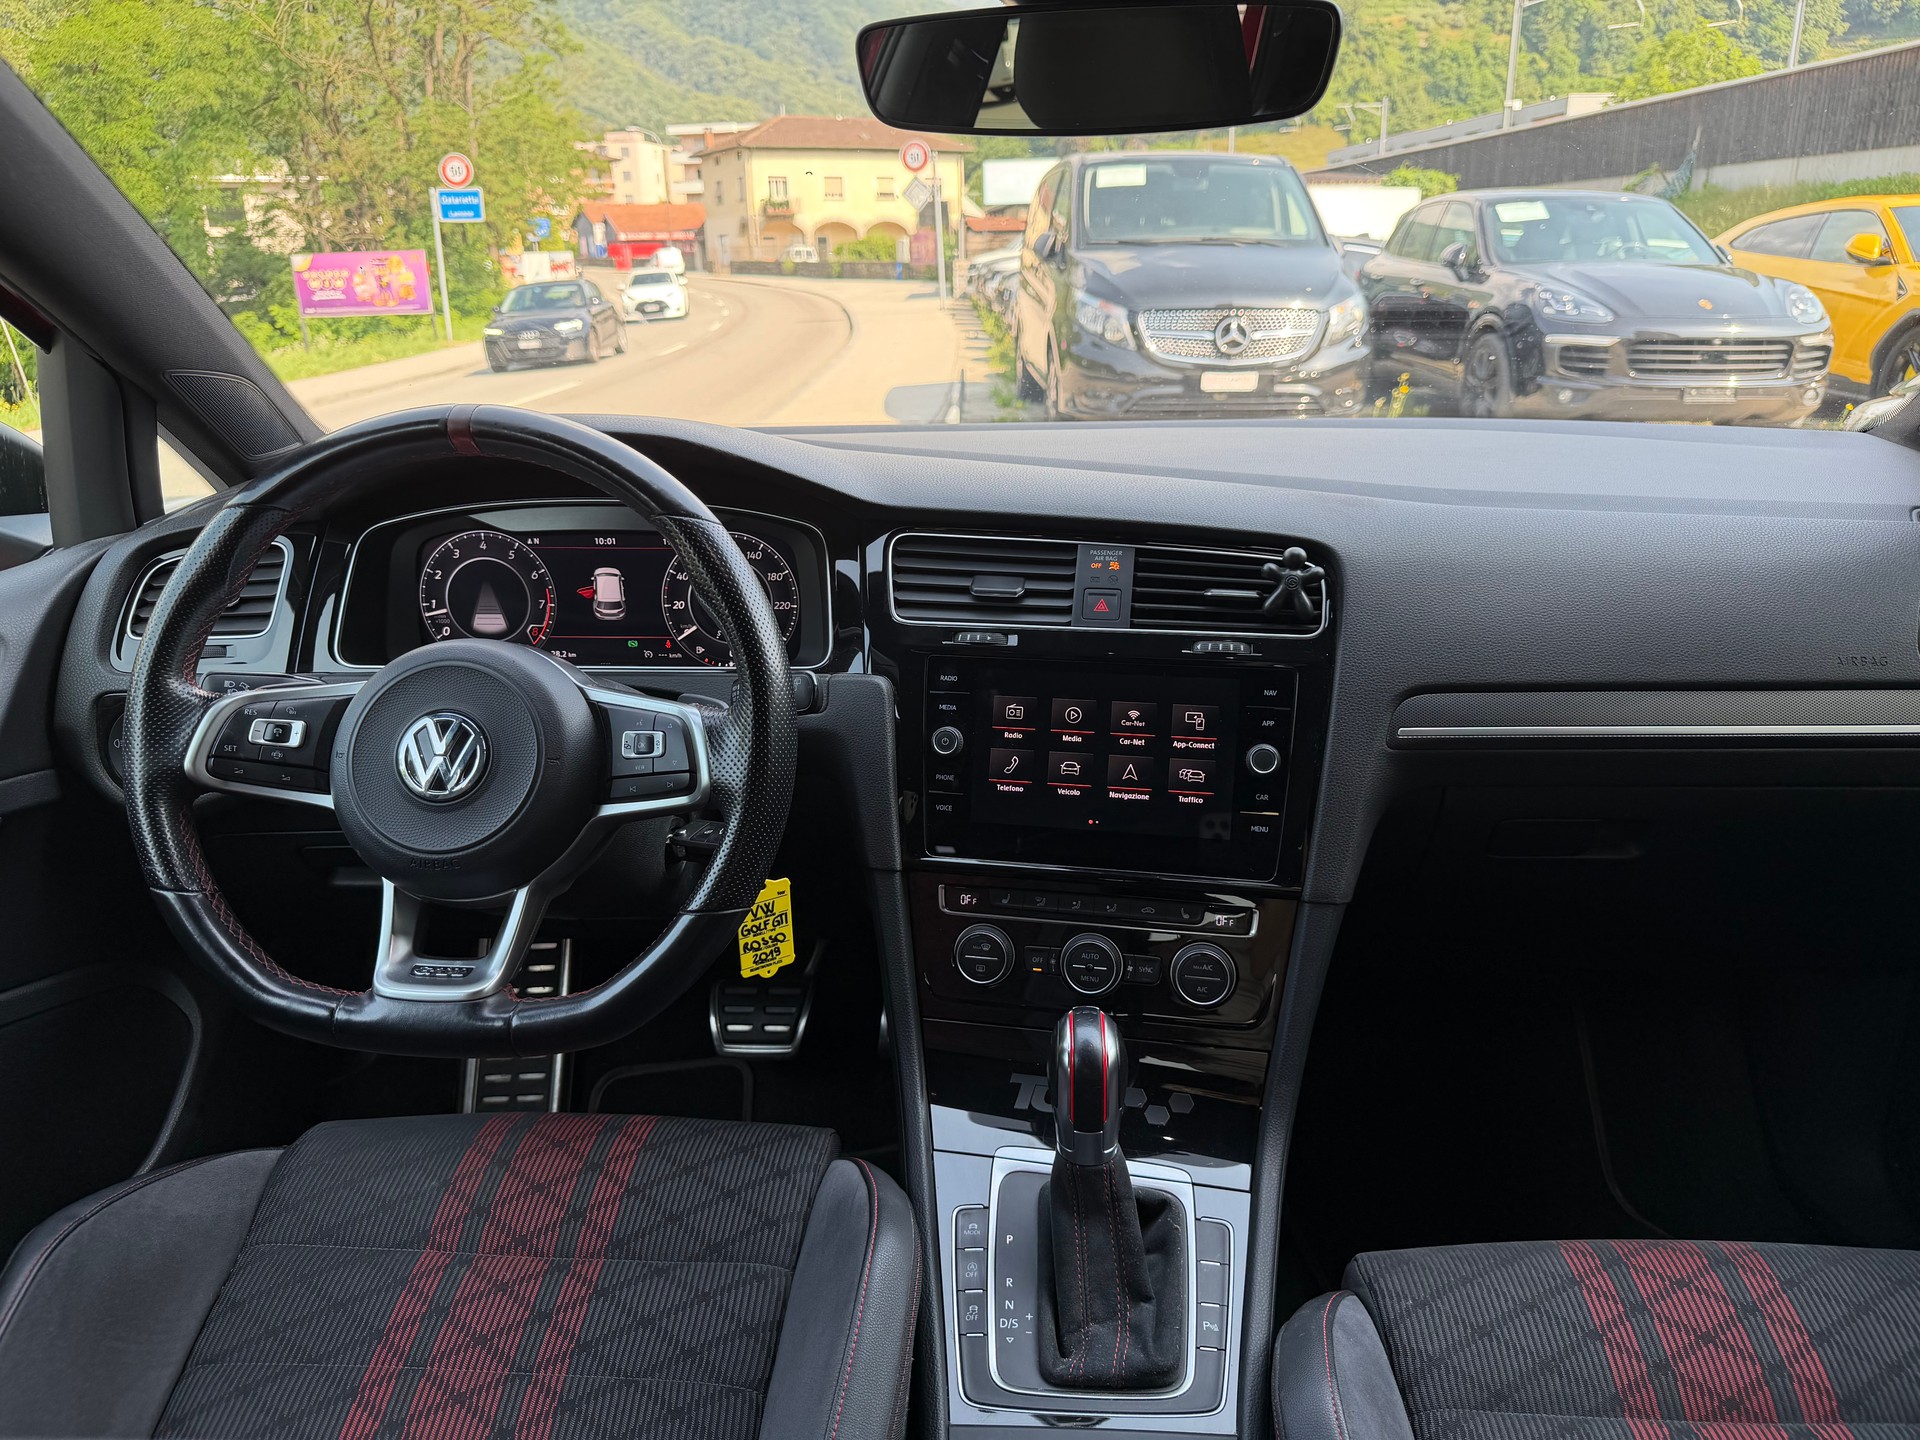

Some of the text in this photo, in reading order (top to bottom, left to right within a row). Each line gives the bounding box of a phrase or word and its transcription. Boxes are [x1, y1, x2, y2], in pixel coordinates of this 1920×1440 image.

[479, 541, 487, 550] 4
[594, 537, 616, 545] 10:01
[452, 549, 460, 559] 3
[508, 550, 515, 559] 5
[746, 551, 762, 560] 140
[434, 570, 442, 580] 2
[531, 570, 539, 580] 6
[767, 572, 783, 581] 180
[431, 599, 436, 609] 1
[538, 599, 546, 609] 7
[672, 600, 685, 609] 20
[774, 601, 791, 610] 220
[442, 626, 451, 636] 0
[531, 627, 538, 636] 8
[1837, 656, 1888, 667] AIRBAG
[244, 708, 258, 716] RES
[1004, 731, 1023, 739] Radio
[1062, 734, 1082, 743] Media
[1119, 737, 1145, 746] Car-Net
[1172, 740, 1215, 750] App-Connect
[223, 744, 237, 752] SET
[996, 784, 1024, 792] Telefono
[1057, 788, 1081, 796] Veicolo
[1108, 791, 1150, 801] Navigazione
[1178, 795, 1204, 804] Traffico
[935, 804, 953, 812] VOICE
[1250, 825, 1269, 833] MENU
[409, 858, 461, 871] AIRBAG
[751, 900, 775, 918] VW
[741, 919, 770, 938] GOLF
[772, 912, 788, 927] GTI
[742, 932, 787, 954] ROSSO
[752, 946, 781, 965] 2019
[1081, 952, 1099, 960] AUTO
[1080, 975, 1099, 983] MENU
[1006, 1235, 1013, 1244] P
[1006, 1278, 1013, 1287] R
[1005, 1300, 1014, 1309] N
[1000, 1318, 1018, 1328] D/S
